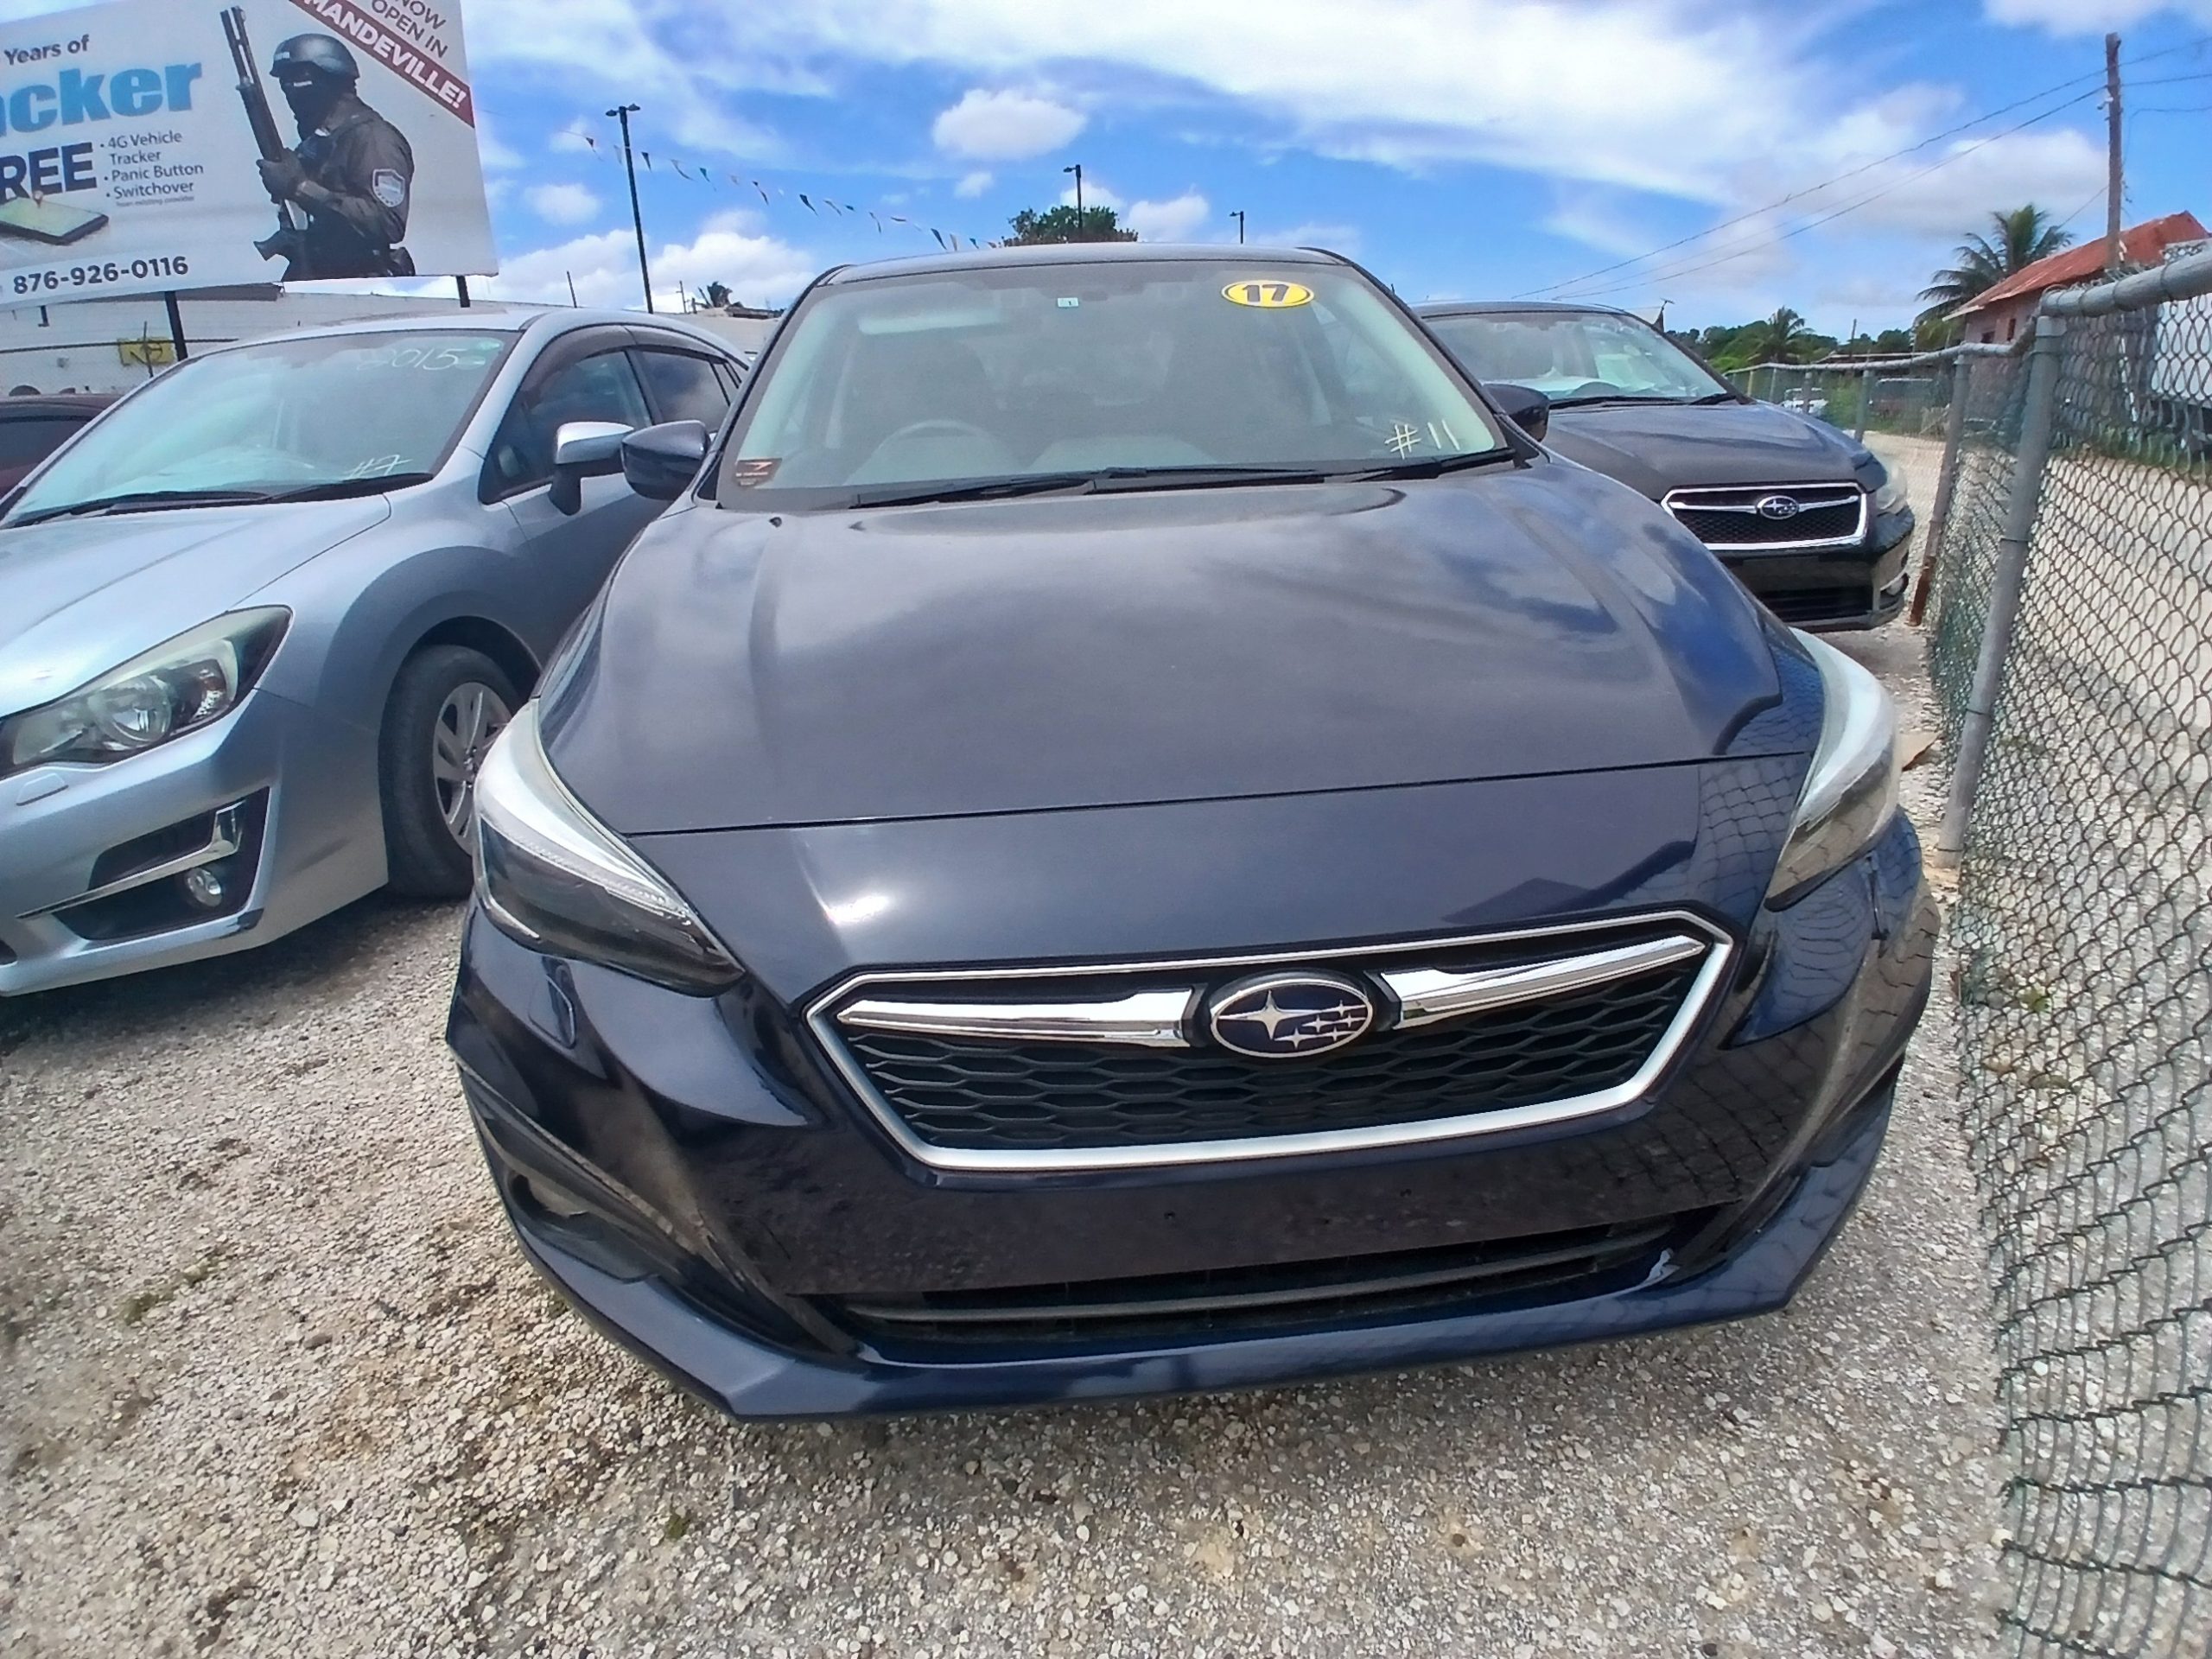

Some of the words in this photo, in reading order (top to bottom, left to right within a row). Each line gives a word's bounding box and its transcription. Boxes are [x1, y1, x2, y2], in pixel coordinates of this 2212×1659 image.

[372, 0, 424, 41] OPEN
[425, 35, 448, 58] IN
[3, 43, 61, 66] Years
[67, 34, 90, 54] of
[304, 0, 466, 109] MANDEVILLE!
[0, 62, 202, 137] cker
[108, 136, 128, 149] 4G
[130, 130, 182, 147] Vehicle
[110, 150, 161, 165] Tracker
[111, 167, 149, 182] Panic
[154, 164, 204, 178] Button
[114, 181, 194, 200] Switchover
[13, 256, 188, 294] 876-926-0116
[1242, 283, 1289, 302] 17
[357, 348, 467, 371] 2015
